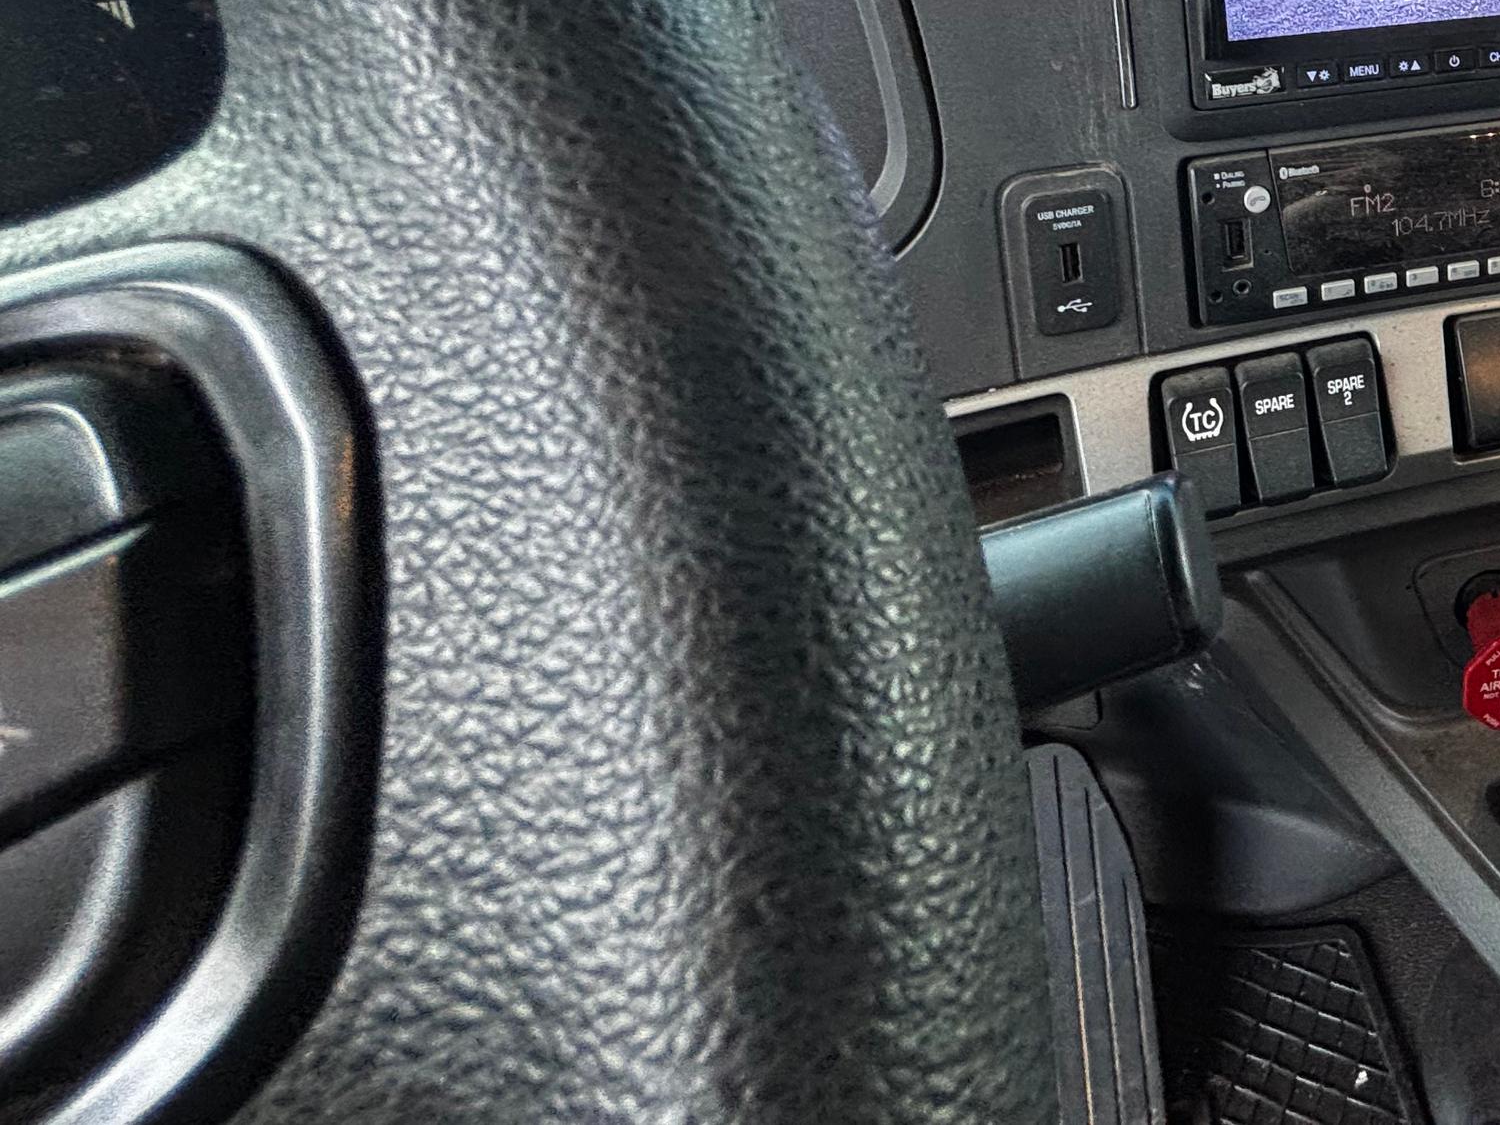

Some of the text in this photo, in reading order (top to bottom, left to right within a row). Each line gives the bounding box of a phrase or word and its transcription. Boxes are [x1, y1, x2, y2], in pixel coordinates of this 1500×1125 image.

[1349, 64, 1380, 77] MENU
[1211, 81, 1258, 97] Buyers
[1037, 205, 1095, 221] USB CHARGER
[1350, 193, 1397, 217] FM2
[1326, 375, 1365, 395] SPARE
[1254, 393, 1295, 416] SPARE
[1343, 391, 1353, 406] 2
[1190, 409, 1216, 431] TC
